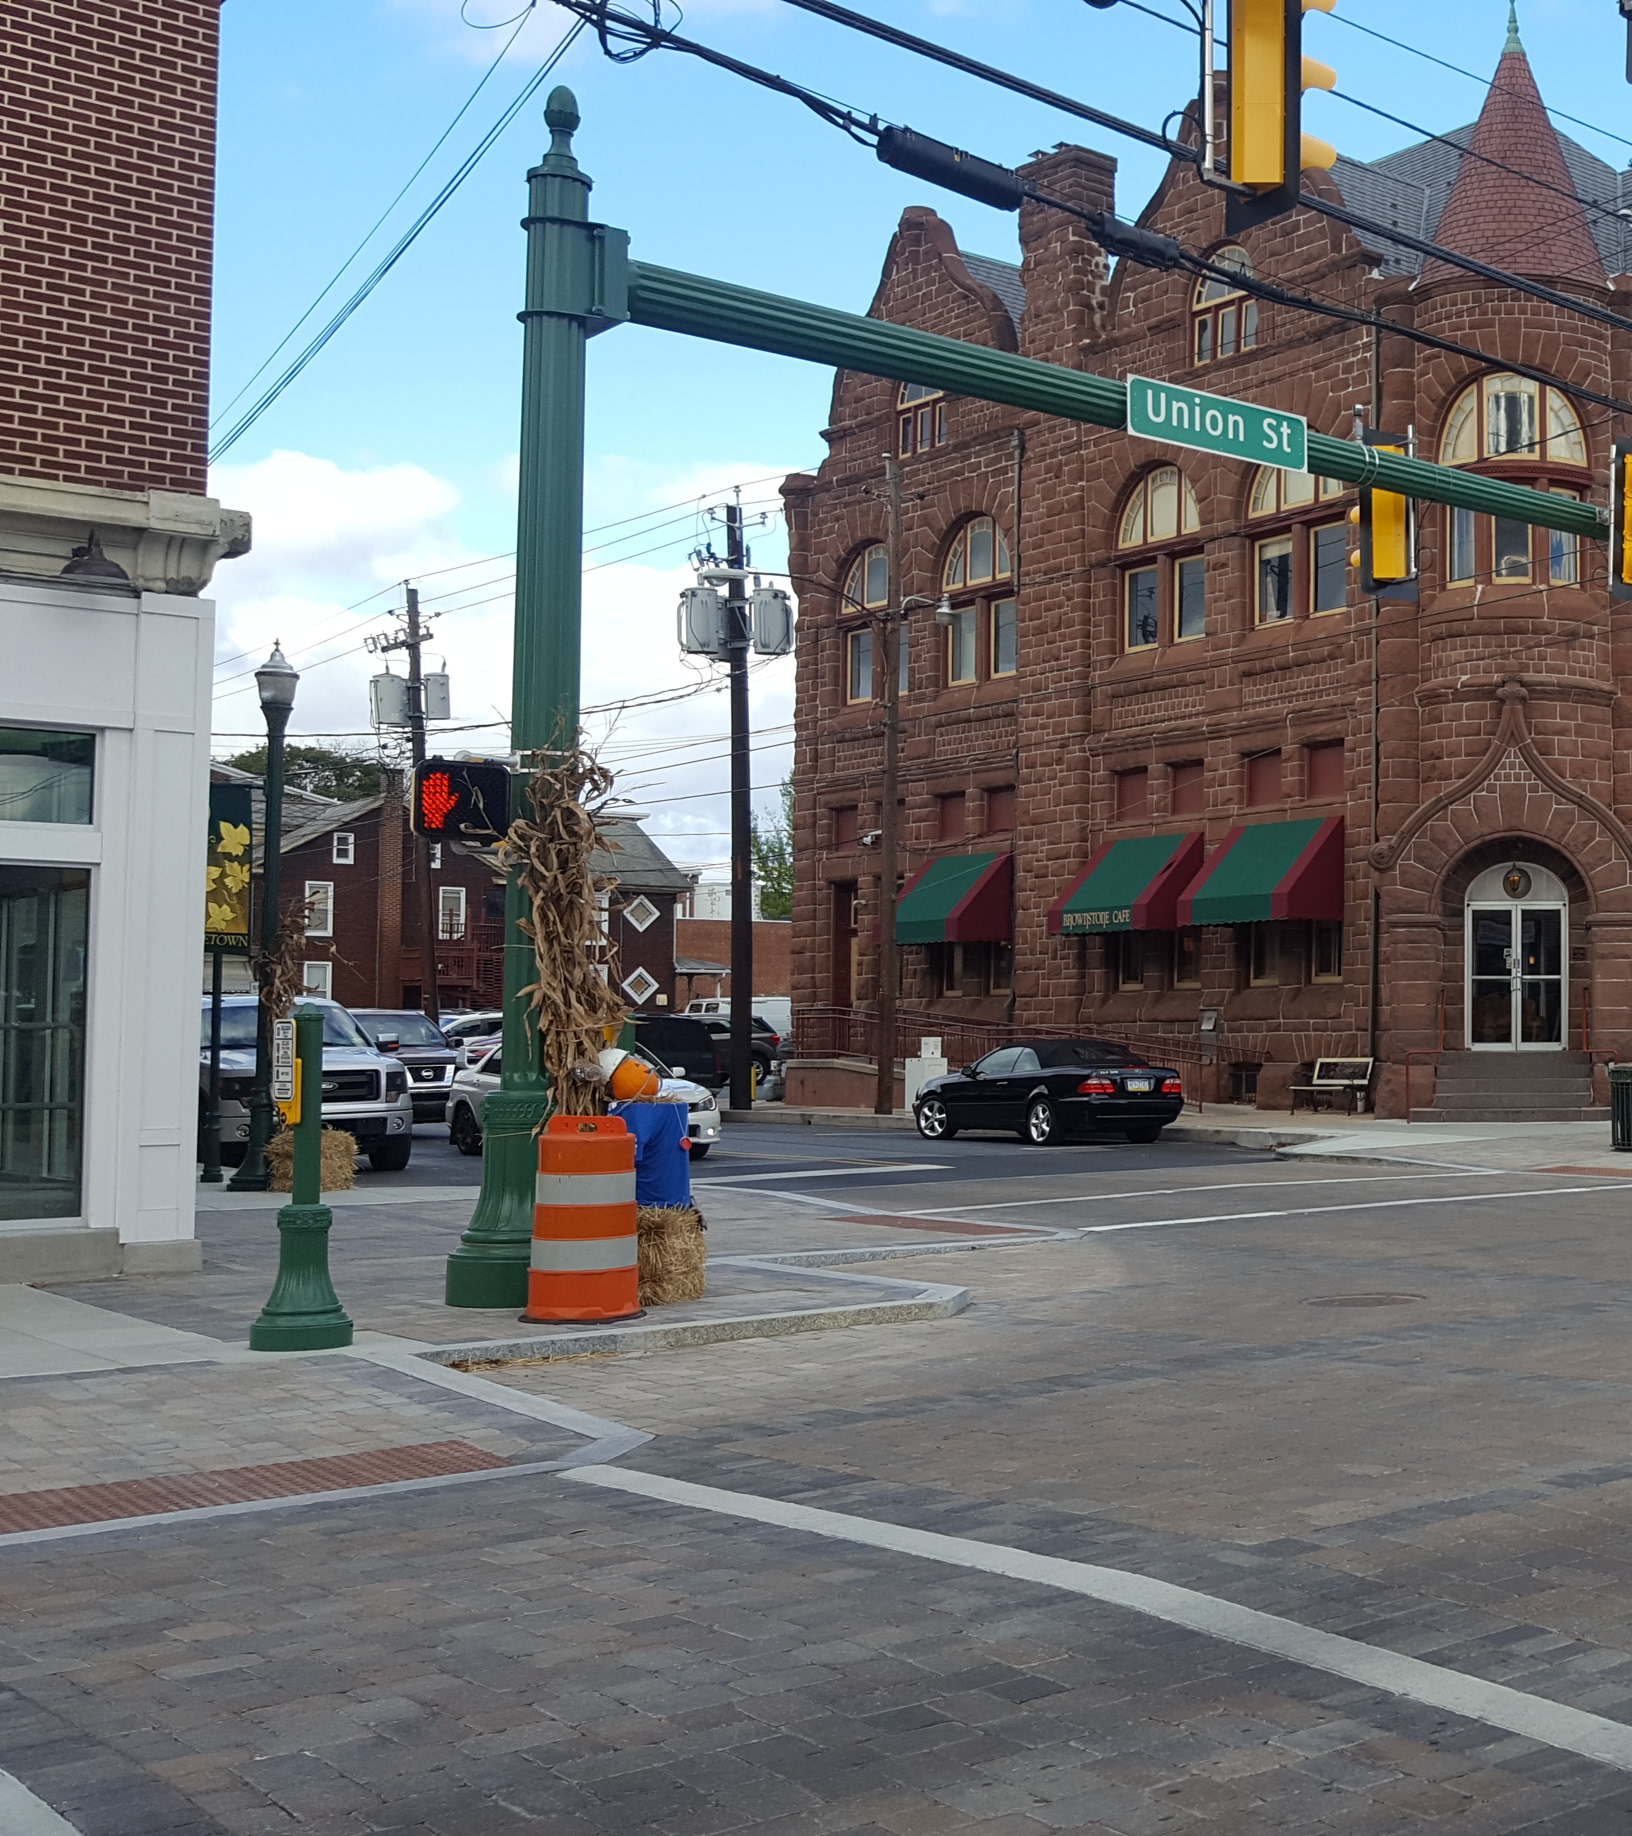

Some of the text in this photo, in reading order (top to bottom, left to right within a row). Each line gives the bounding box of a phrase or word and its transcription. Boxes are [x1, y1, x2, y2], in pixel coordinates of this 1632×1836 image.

[1146, 388, 1292, 453] Union St
[1063, 909, 1131, 930] BROWNSTONE CAFE
